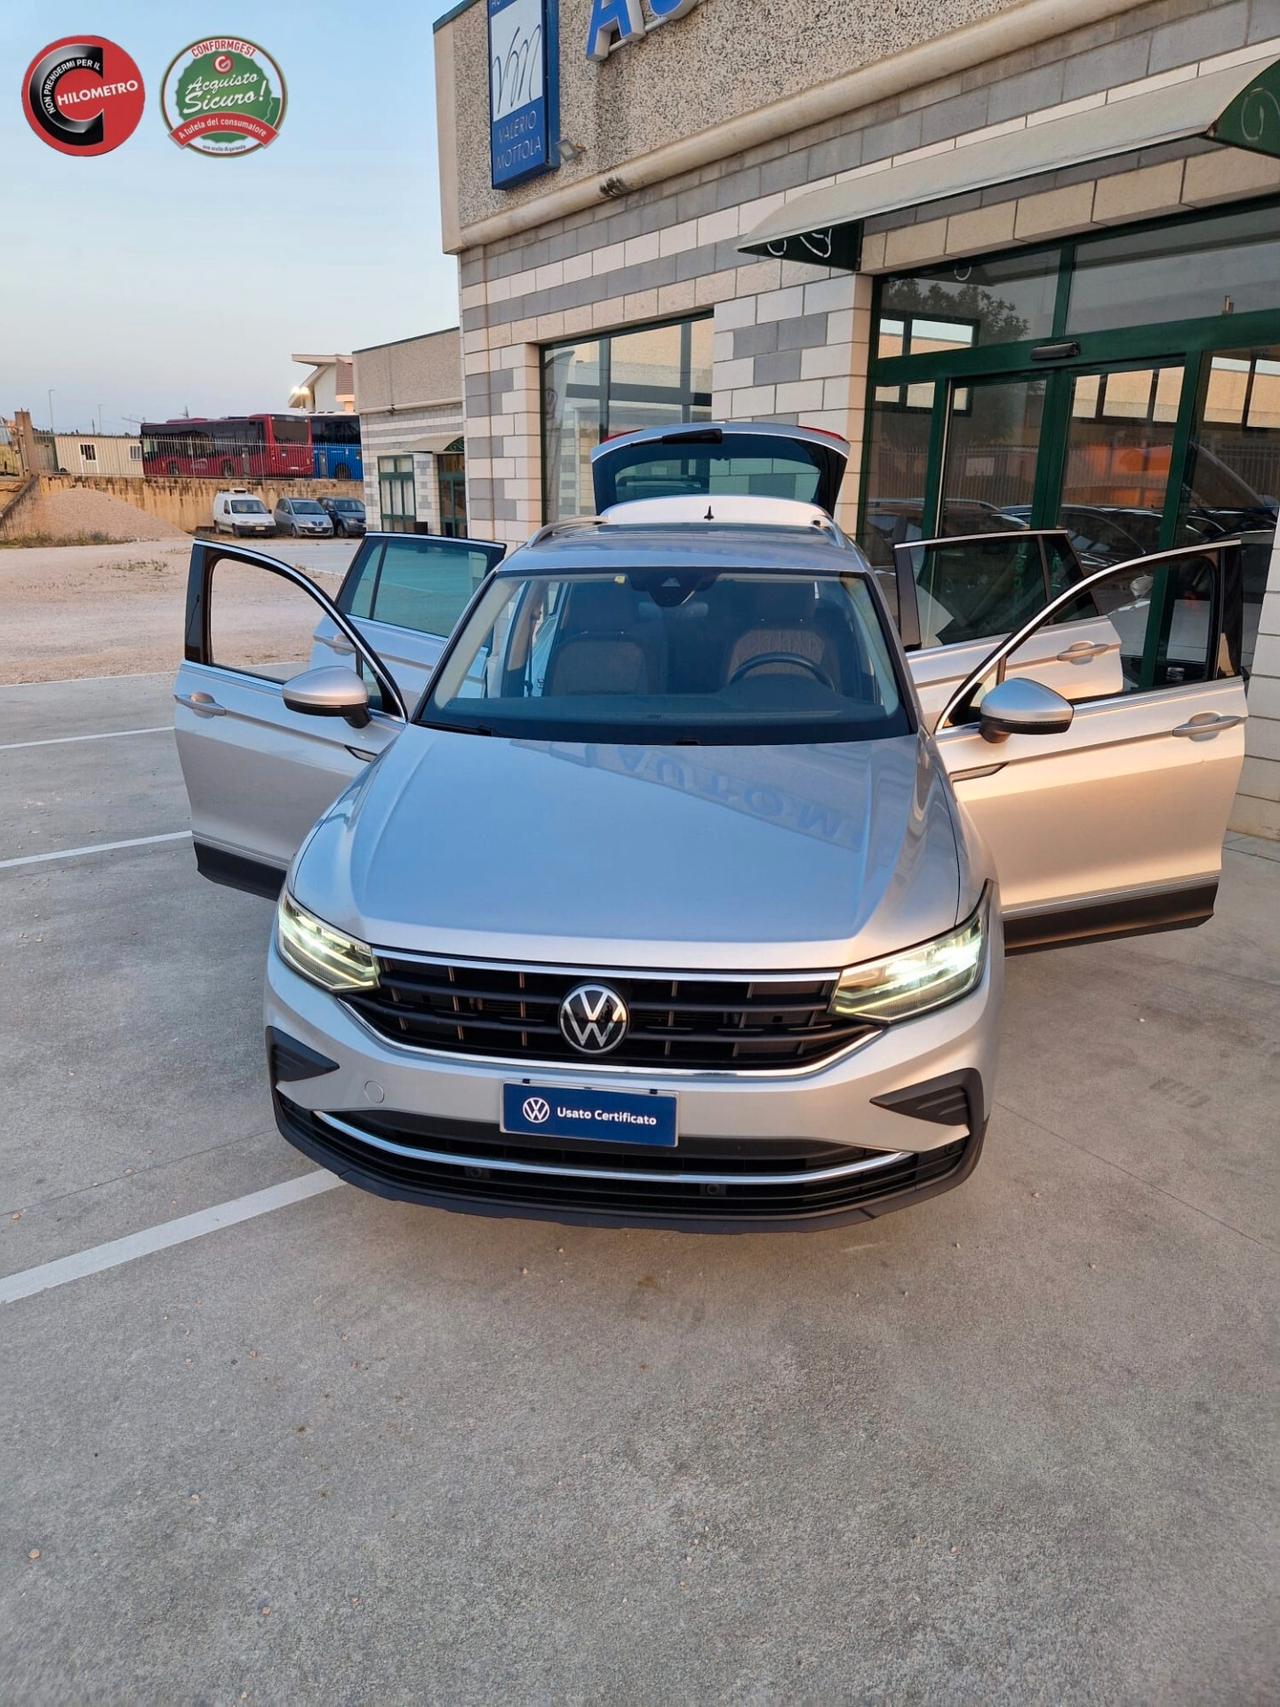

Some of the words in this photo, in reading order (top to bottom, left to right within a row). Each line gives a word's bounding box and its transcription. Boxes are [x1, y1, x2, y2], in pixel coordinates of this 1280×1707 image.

[498, 110, 537, 143] VALERIO
[557, 1107, 592, 1120] Usato
[594, 1109, 657, 1126] Certificato
